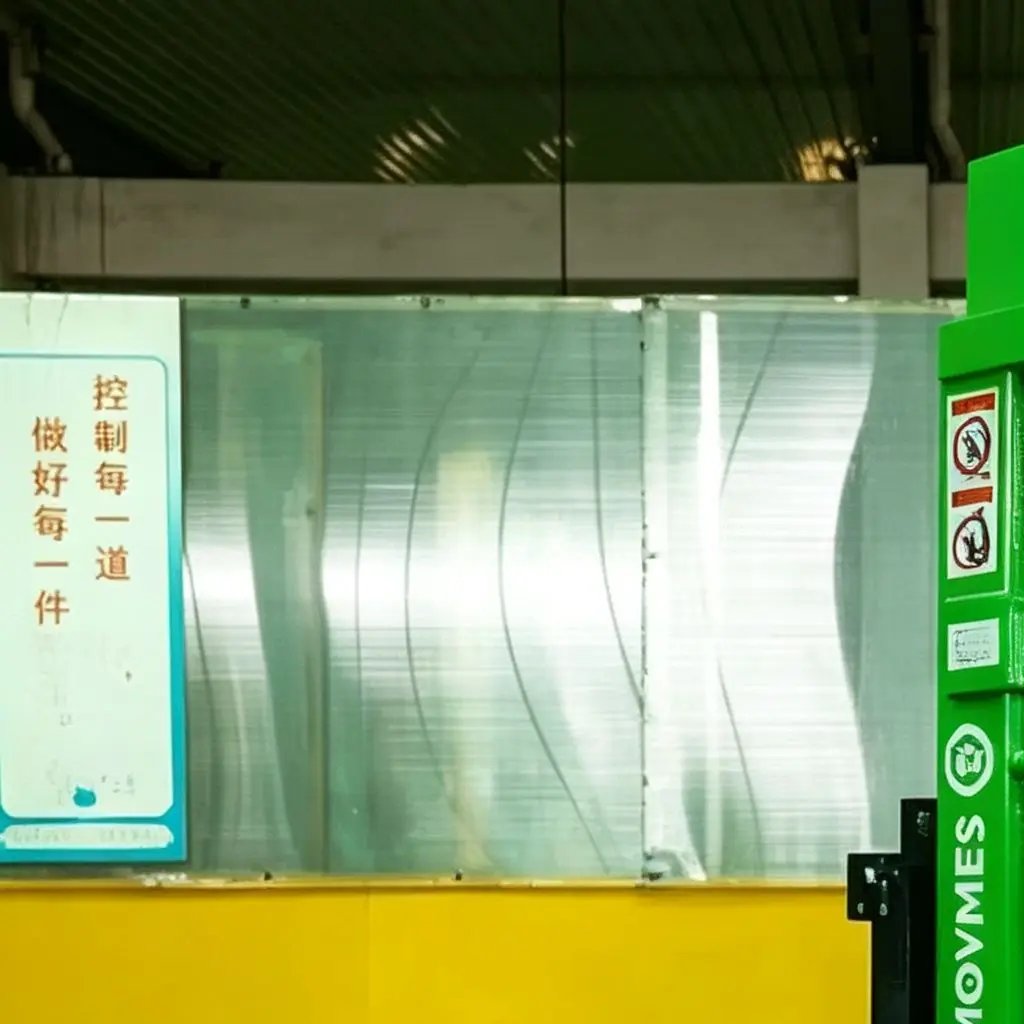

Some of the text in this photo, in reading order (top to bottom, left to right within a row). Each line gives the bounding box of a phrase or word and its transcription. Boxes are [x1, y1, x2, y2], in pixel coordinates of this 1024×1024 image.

[32, 417, 69, 625] 做好每一件
[94, 374, 130, 581] 控制每一道
